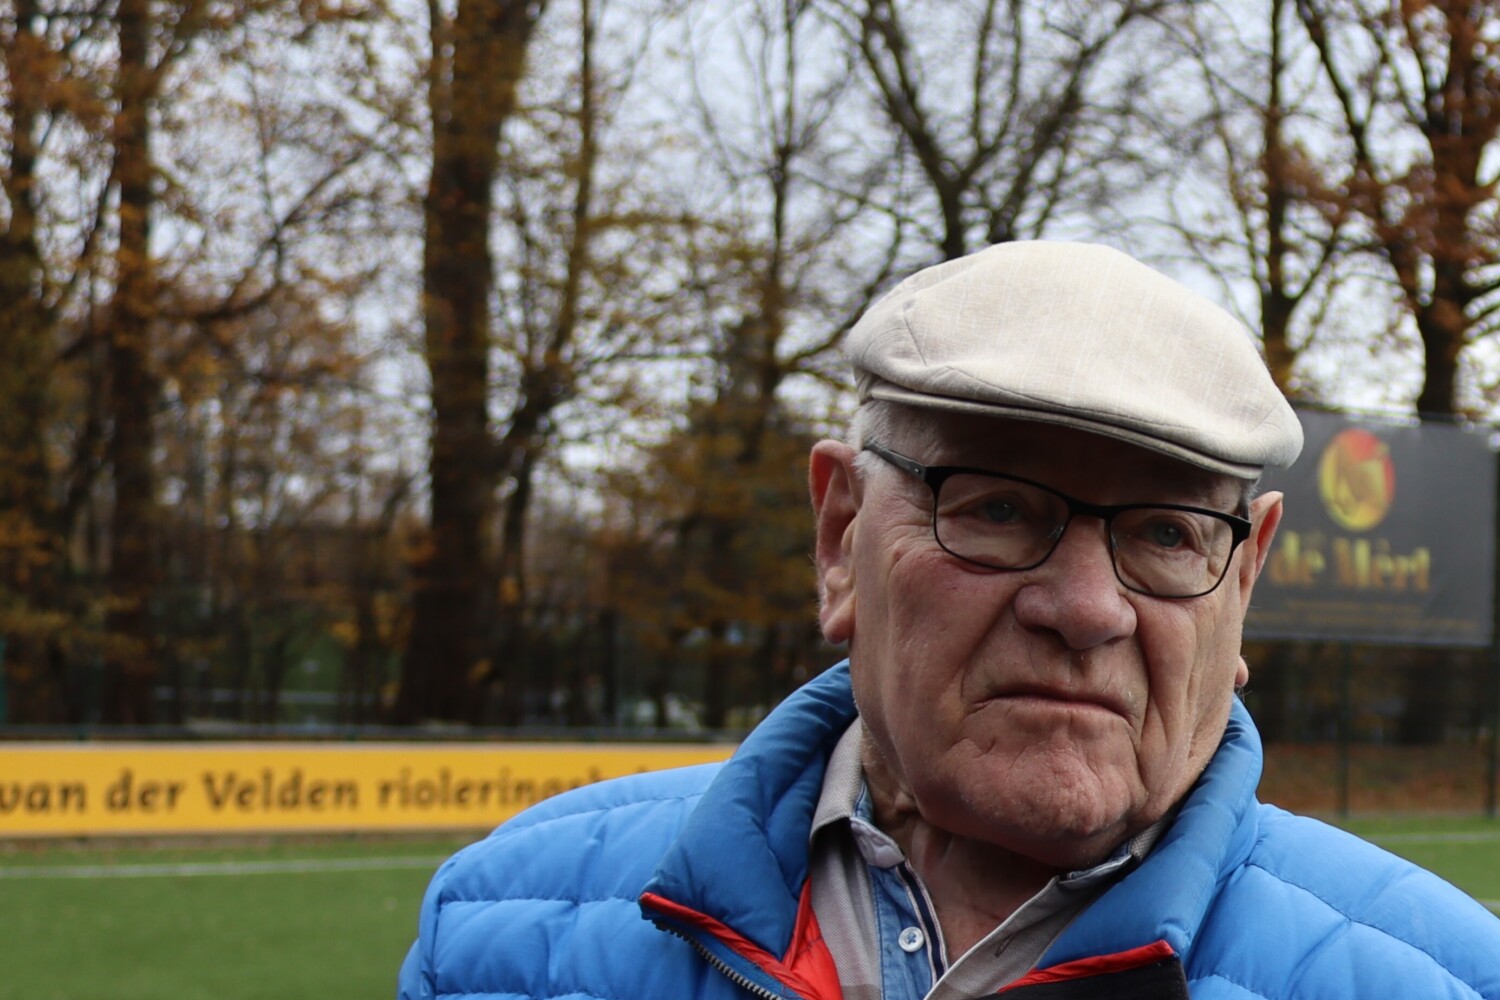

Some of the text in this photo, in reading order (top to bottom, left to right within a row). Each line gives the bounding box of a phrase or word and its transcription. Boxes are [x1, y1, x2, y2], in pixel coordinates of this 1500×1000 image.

[0, 778, 89, 816] van
[105, 767, 187, 814] der
[202, 766, 362, 813] Velden
